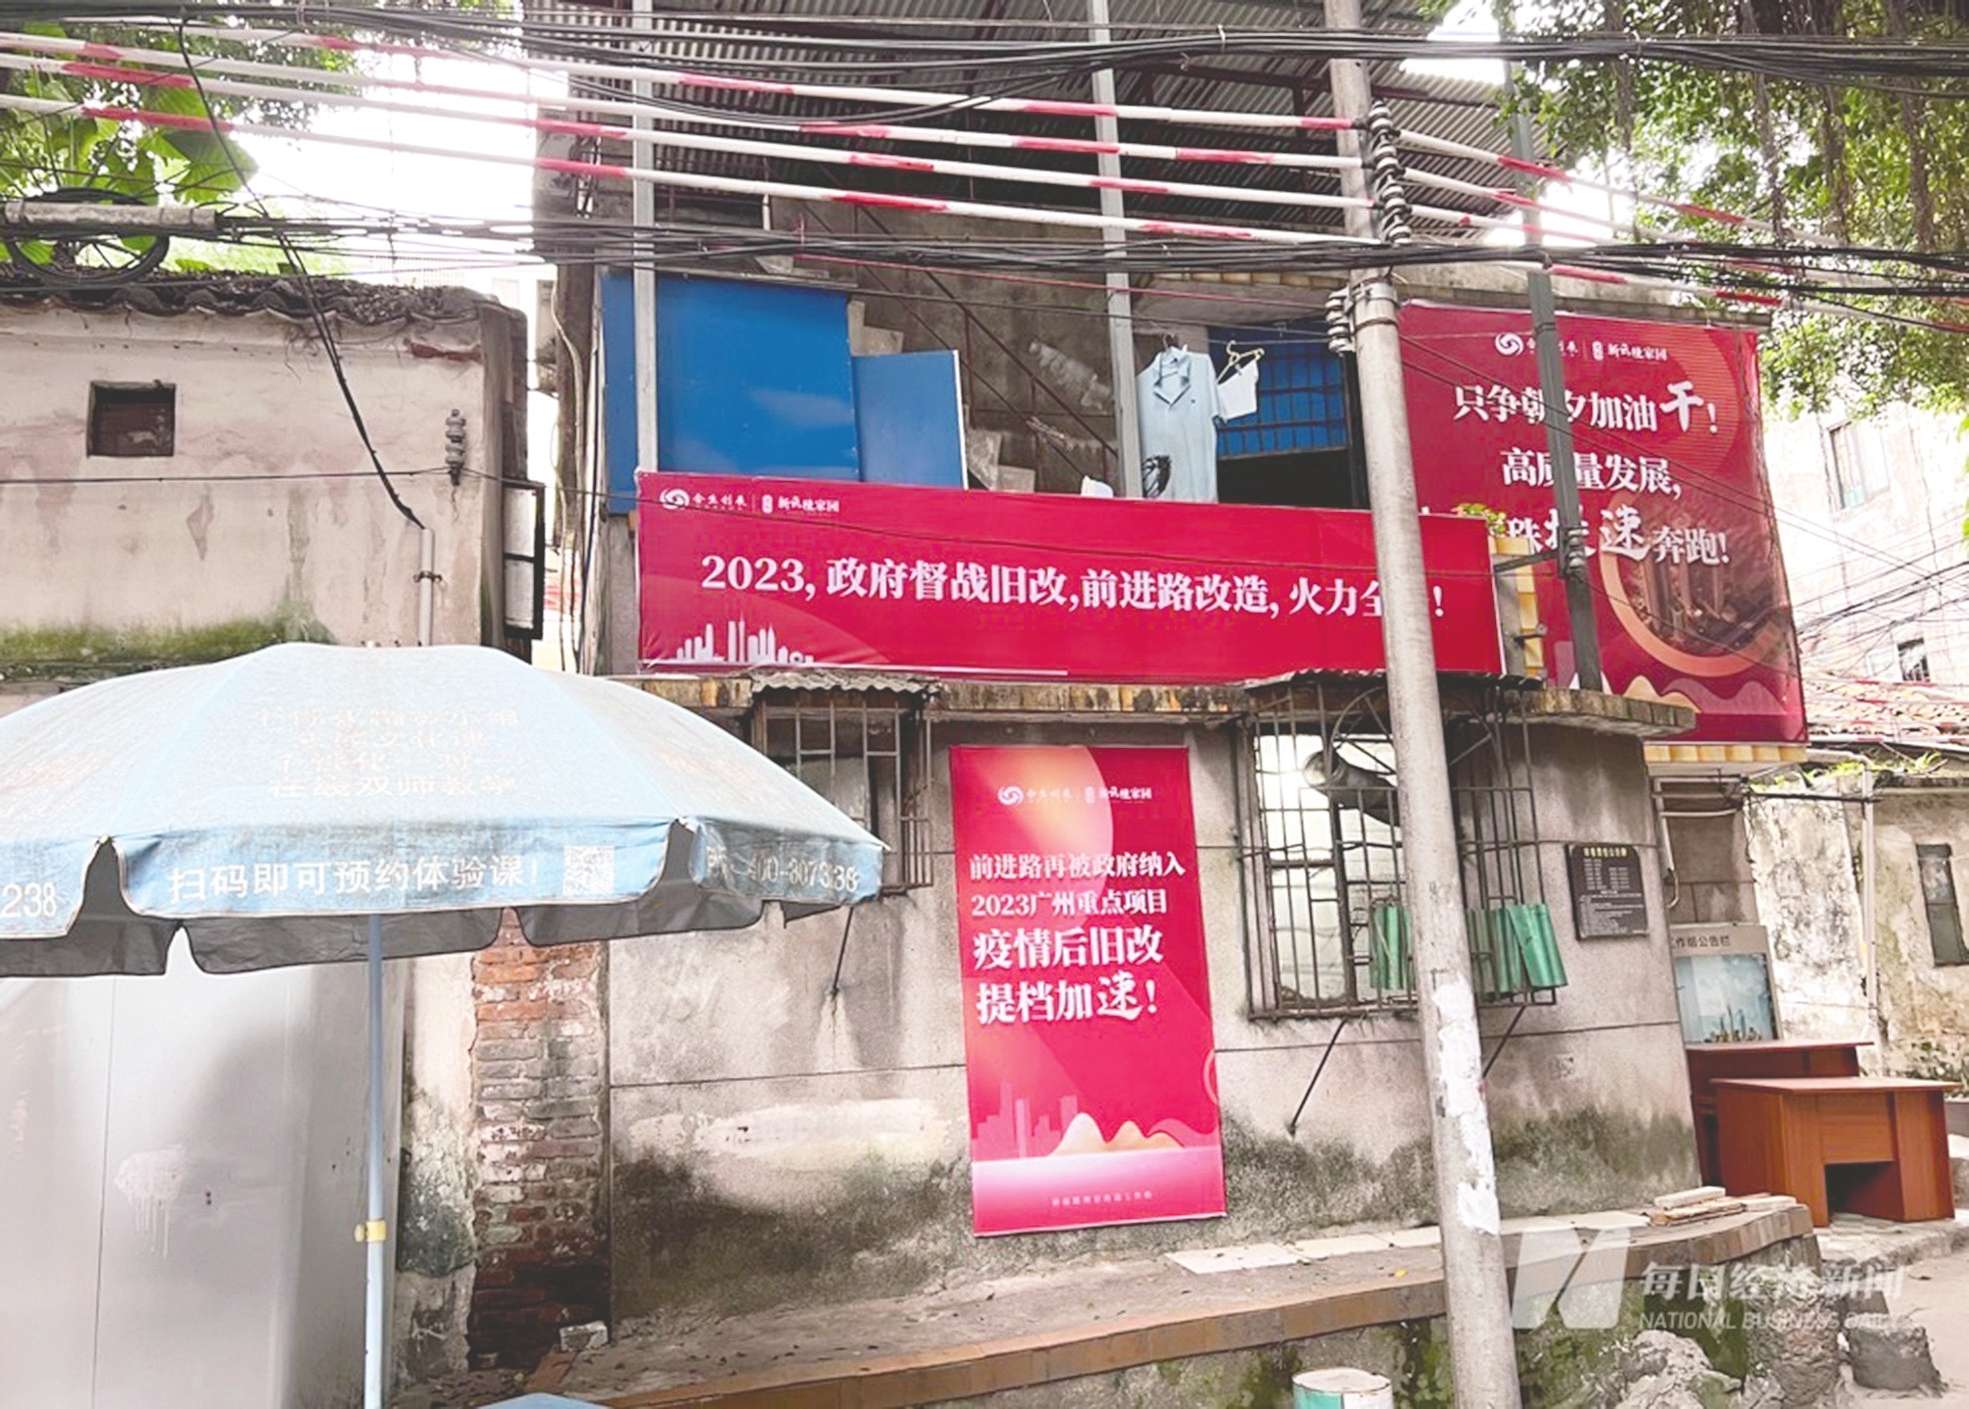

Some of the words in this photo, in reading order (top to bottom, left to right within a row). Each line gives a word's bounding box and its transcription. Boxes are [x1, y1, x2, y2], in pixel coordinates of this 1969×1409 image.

[1453, 380, 1719, 434] 只争朝夕加油干！
[1490, 504, 1730, 566] 珠速奔跑！
[701, 555, 1446, 620] 2023，政府督战旧改，前进路改造，火力全！
[168, 855, 538, 902] 扫码即可预约体验课！
[969, 851, 1186, 880] 前进路再被政府纳入
[0, 882, 56, 918] 238
[971, 888, 1168, 917] 2023广州重点项目
[973, 924, 1164, 970] 疫情后旧改
[976, 970, 1157, 1025] 提档加速！
